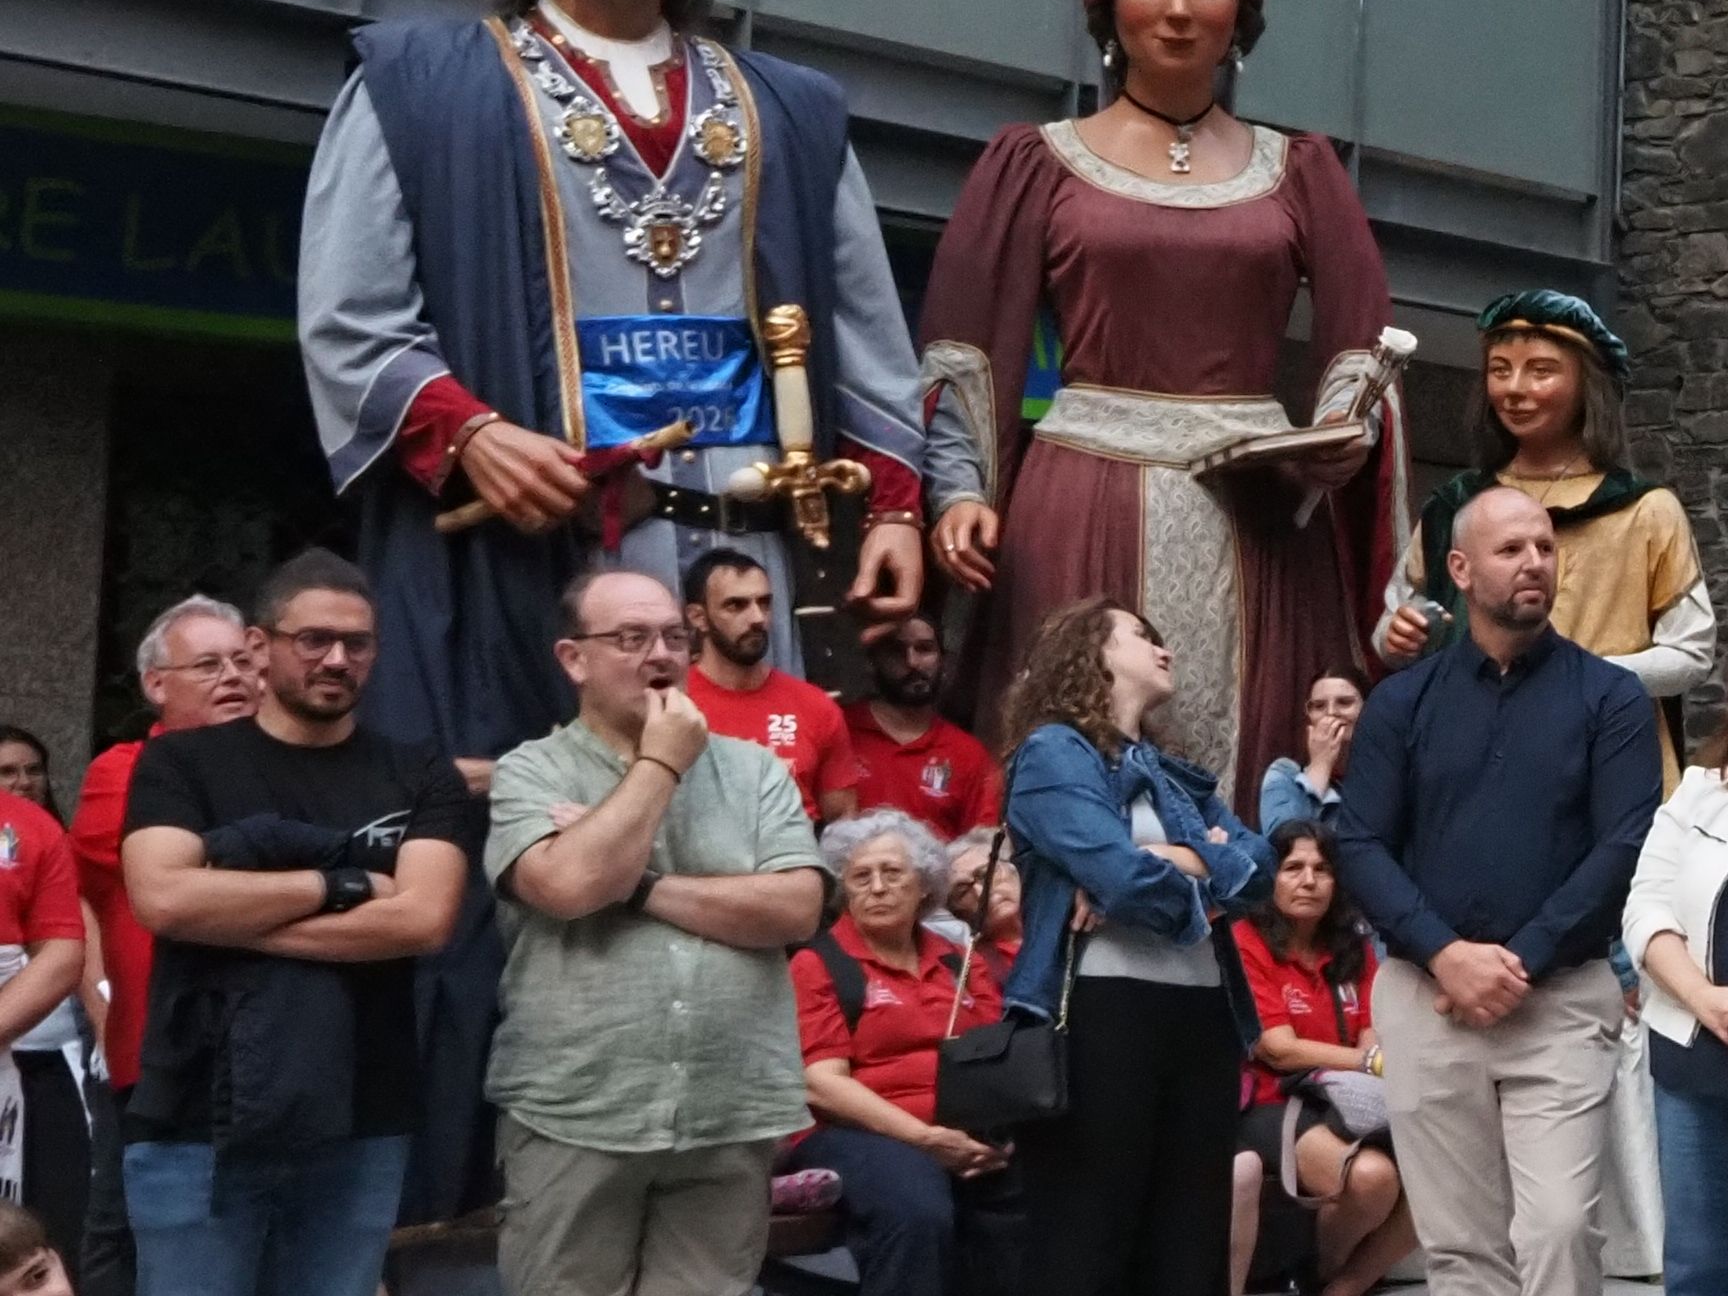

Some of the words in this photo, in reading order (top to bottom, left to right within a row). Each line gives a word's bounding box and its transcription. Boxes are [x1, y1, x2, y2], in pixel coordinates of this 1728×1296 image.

[0, 175, 82, 262] E
[600, 330, 725, 366] HEREU
[768, 714, 798, 733] 25
